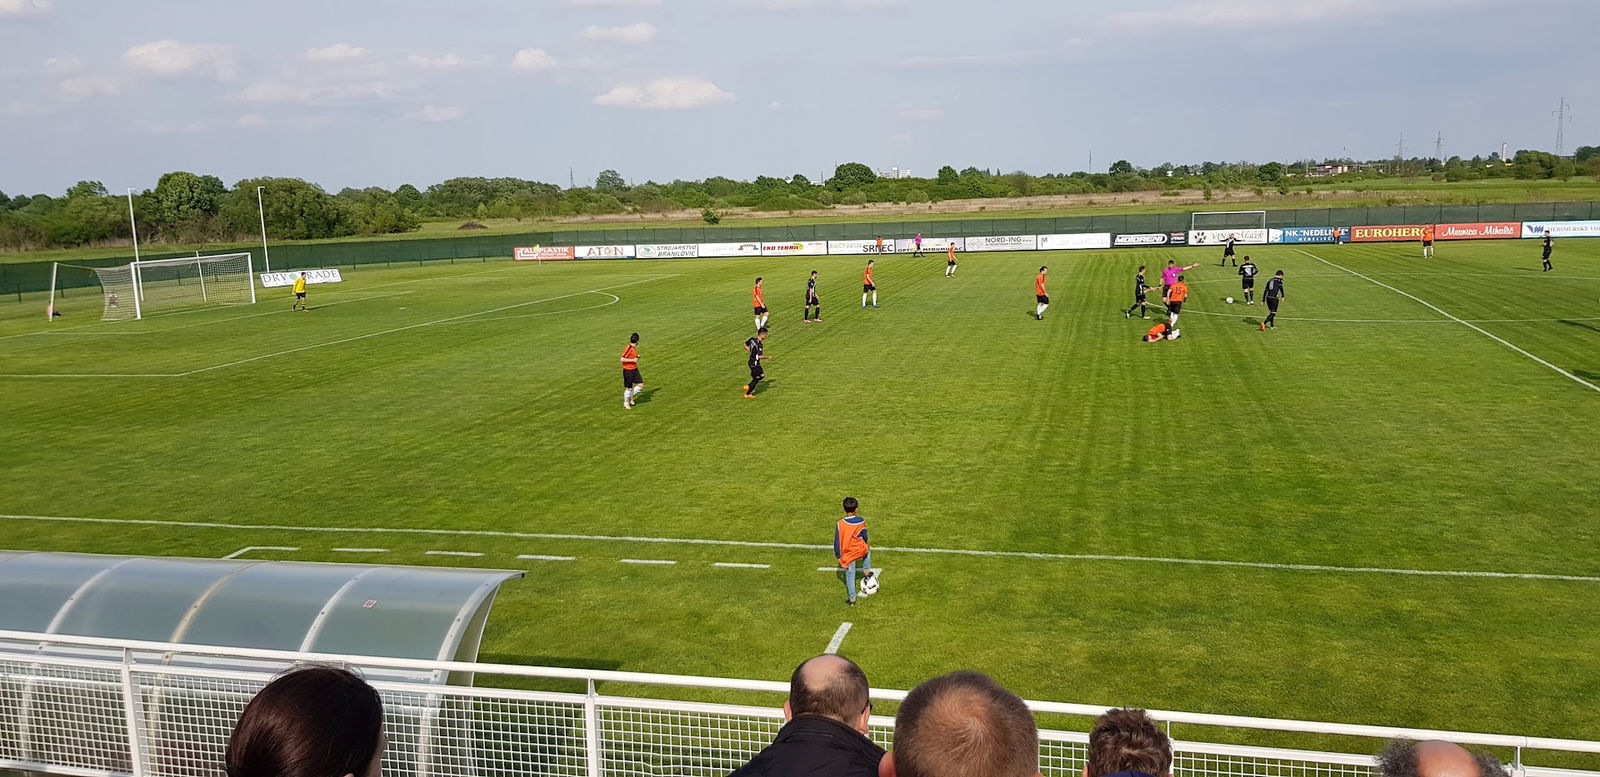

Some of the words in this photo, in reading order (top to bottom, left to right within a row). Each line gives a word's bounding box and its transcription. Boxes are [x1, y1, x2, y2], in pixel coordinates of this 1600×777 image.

[1442, 226, 1478, 236] Mesnica
[587, 246, 624, 256] ATON
[303, 270, 338, 280] RADE
